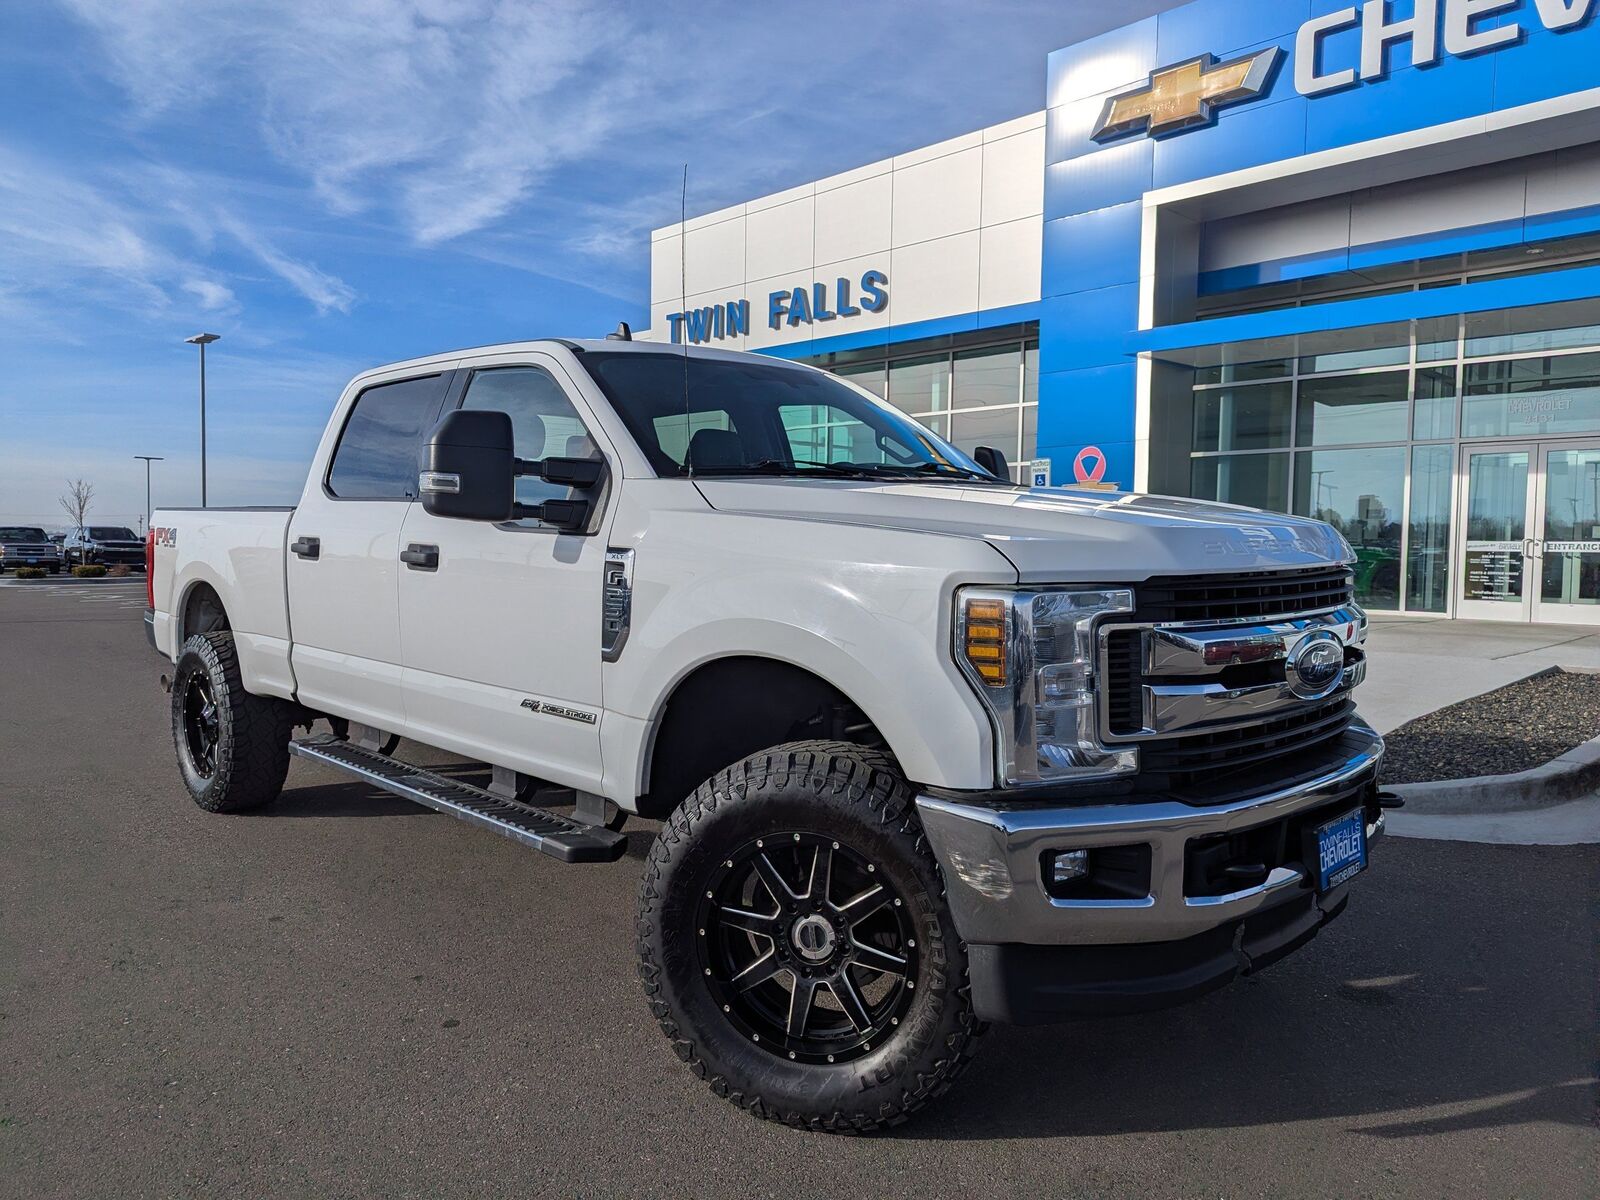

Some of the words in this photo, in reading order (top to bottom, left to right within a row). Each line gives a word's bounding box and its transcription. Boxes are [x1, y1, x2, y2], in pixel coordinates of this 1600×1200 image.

[666, 299, 750, 345] TWIN
[767, 270, 889, 331] FALLS
[156, 527, 177, 545] FX4
[1308, 650, 1336, 679] Ford
[542, 703, 565, 715] POWER
[565, 709, 593, 721] STROKE
[1320, 833, 1361, 873] CHEVROLET
